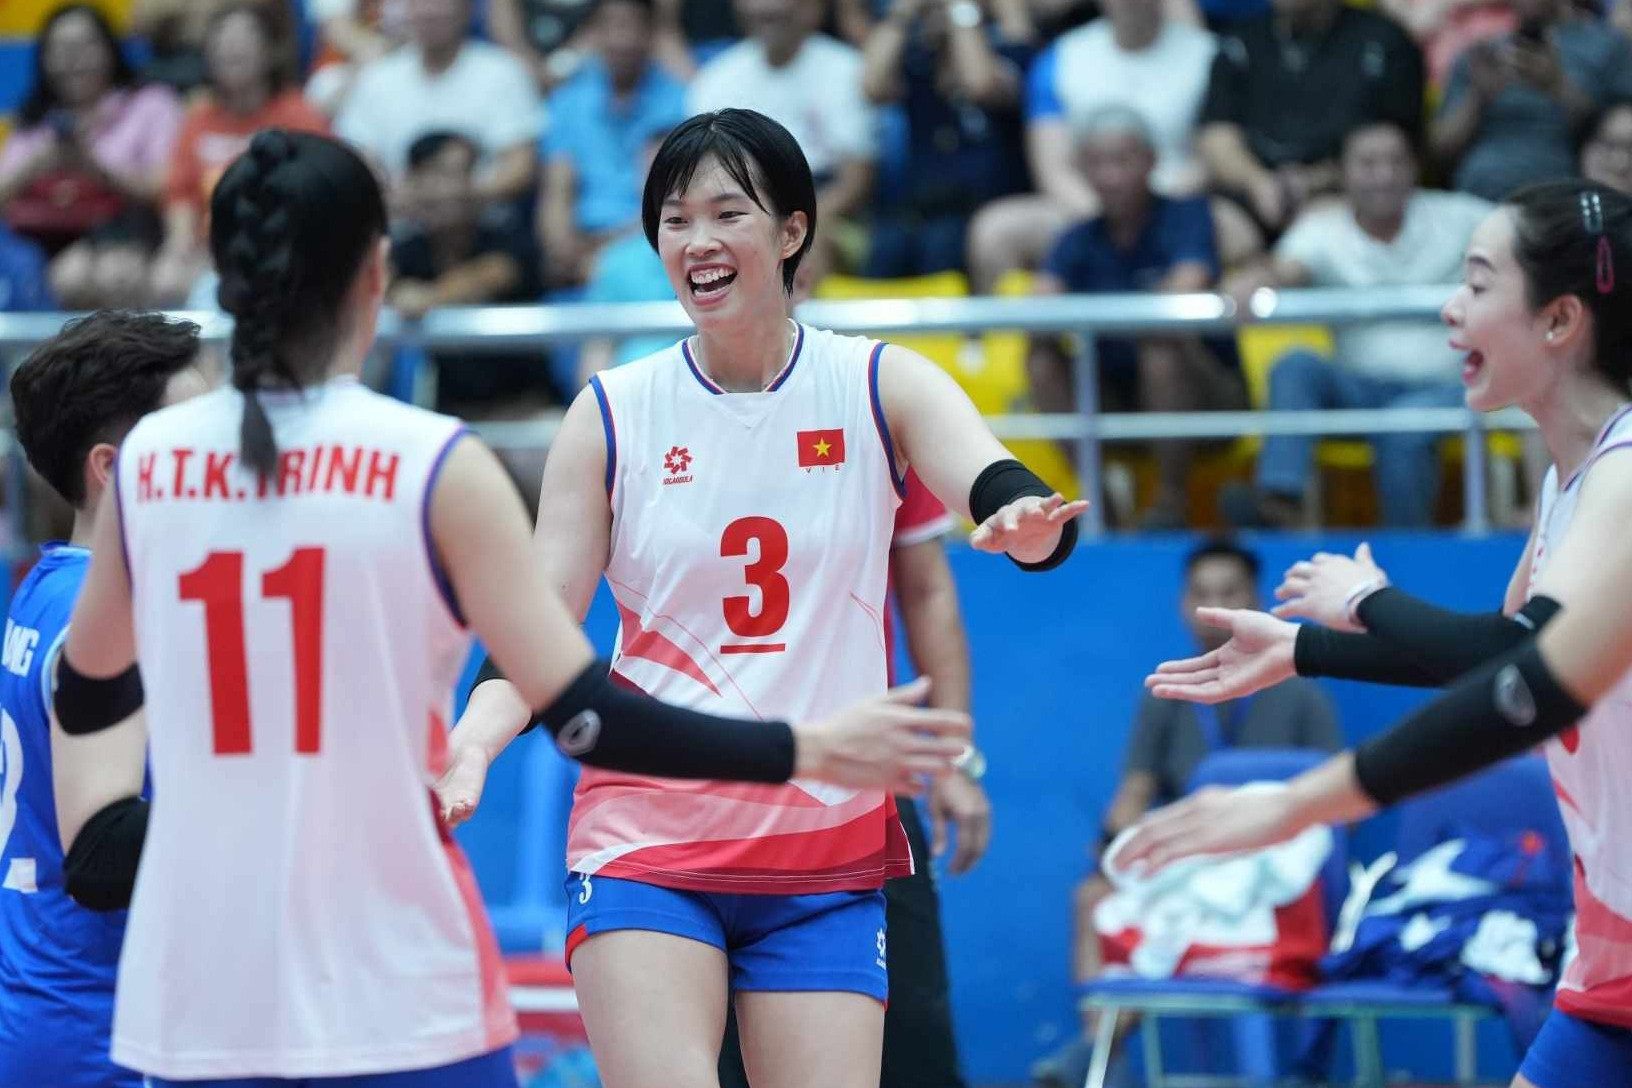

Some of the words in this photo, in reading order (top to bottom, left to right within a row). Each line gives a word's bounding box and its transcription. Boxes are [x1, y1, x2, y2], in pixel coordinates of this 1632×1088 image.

[719, 515, 790, 637] 3
[178, 546, 326, 756] 11
[578, 873, 593, 904] 3
